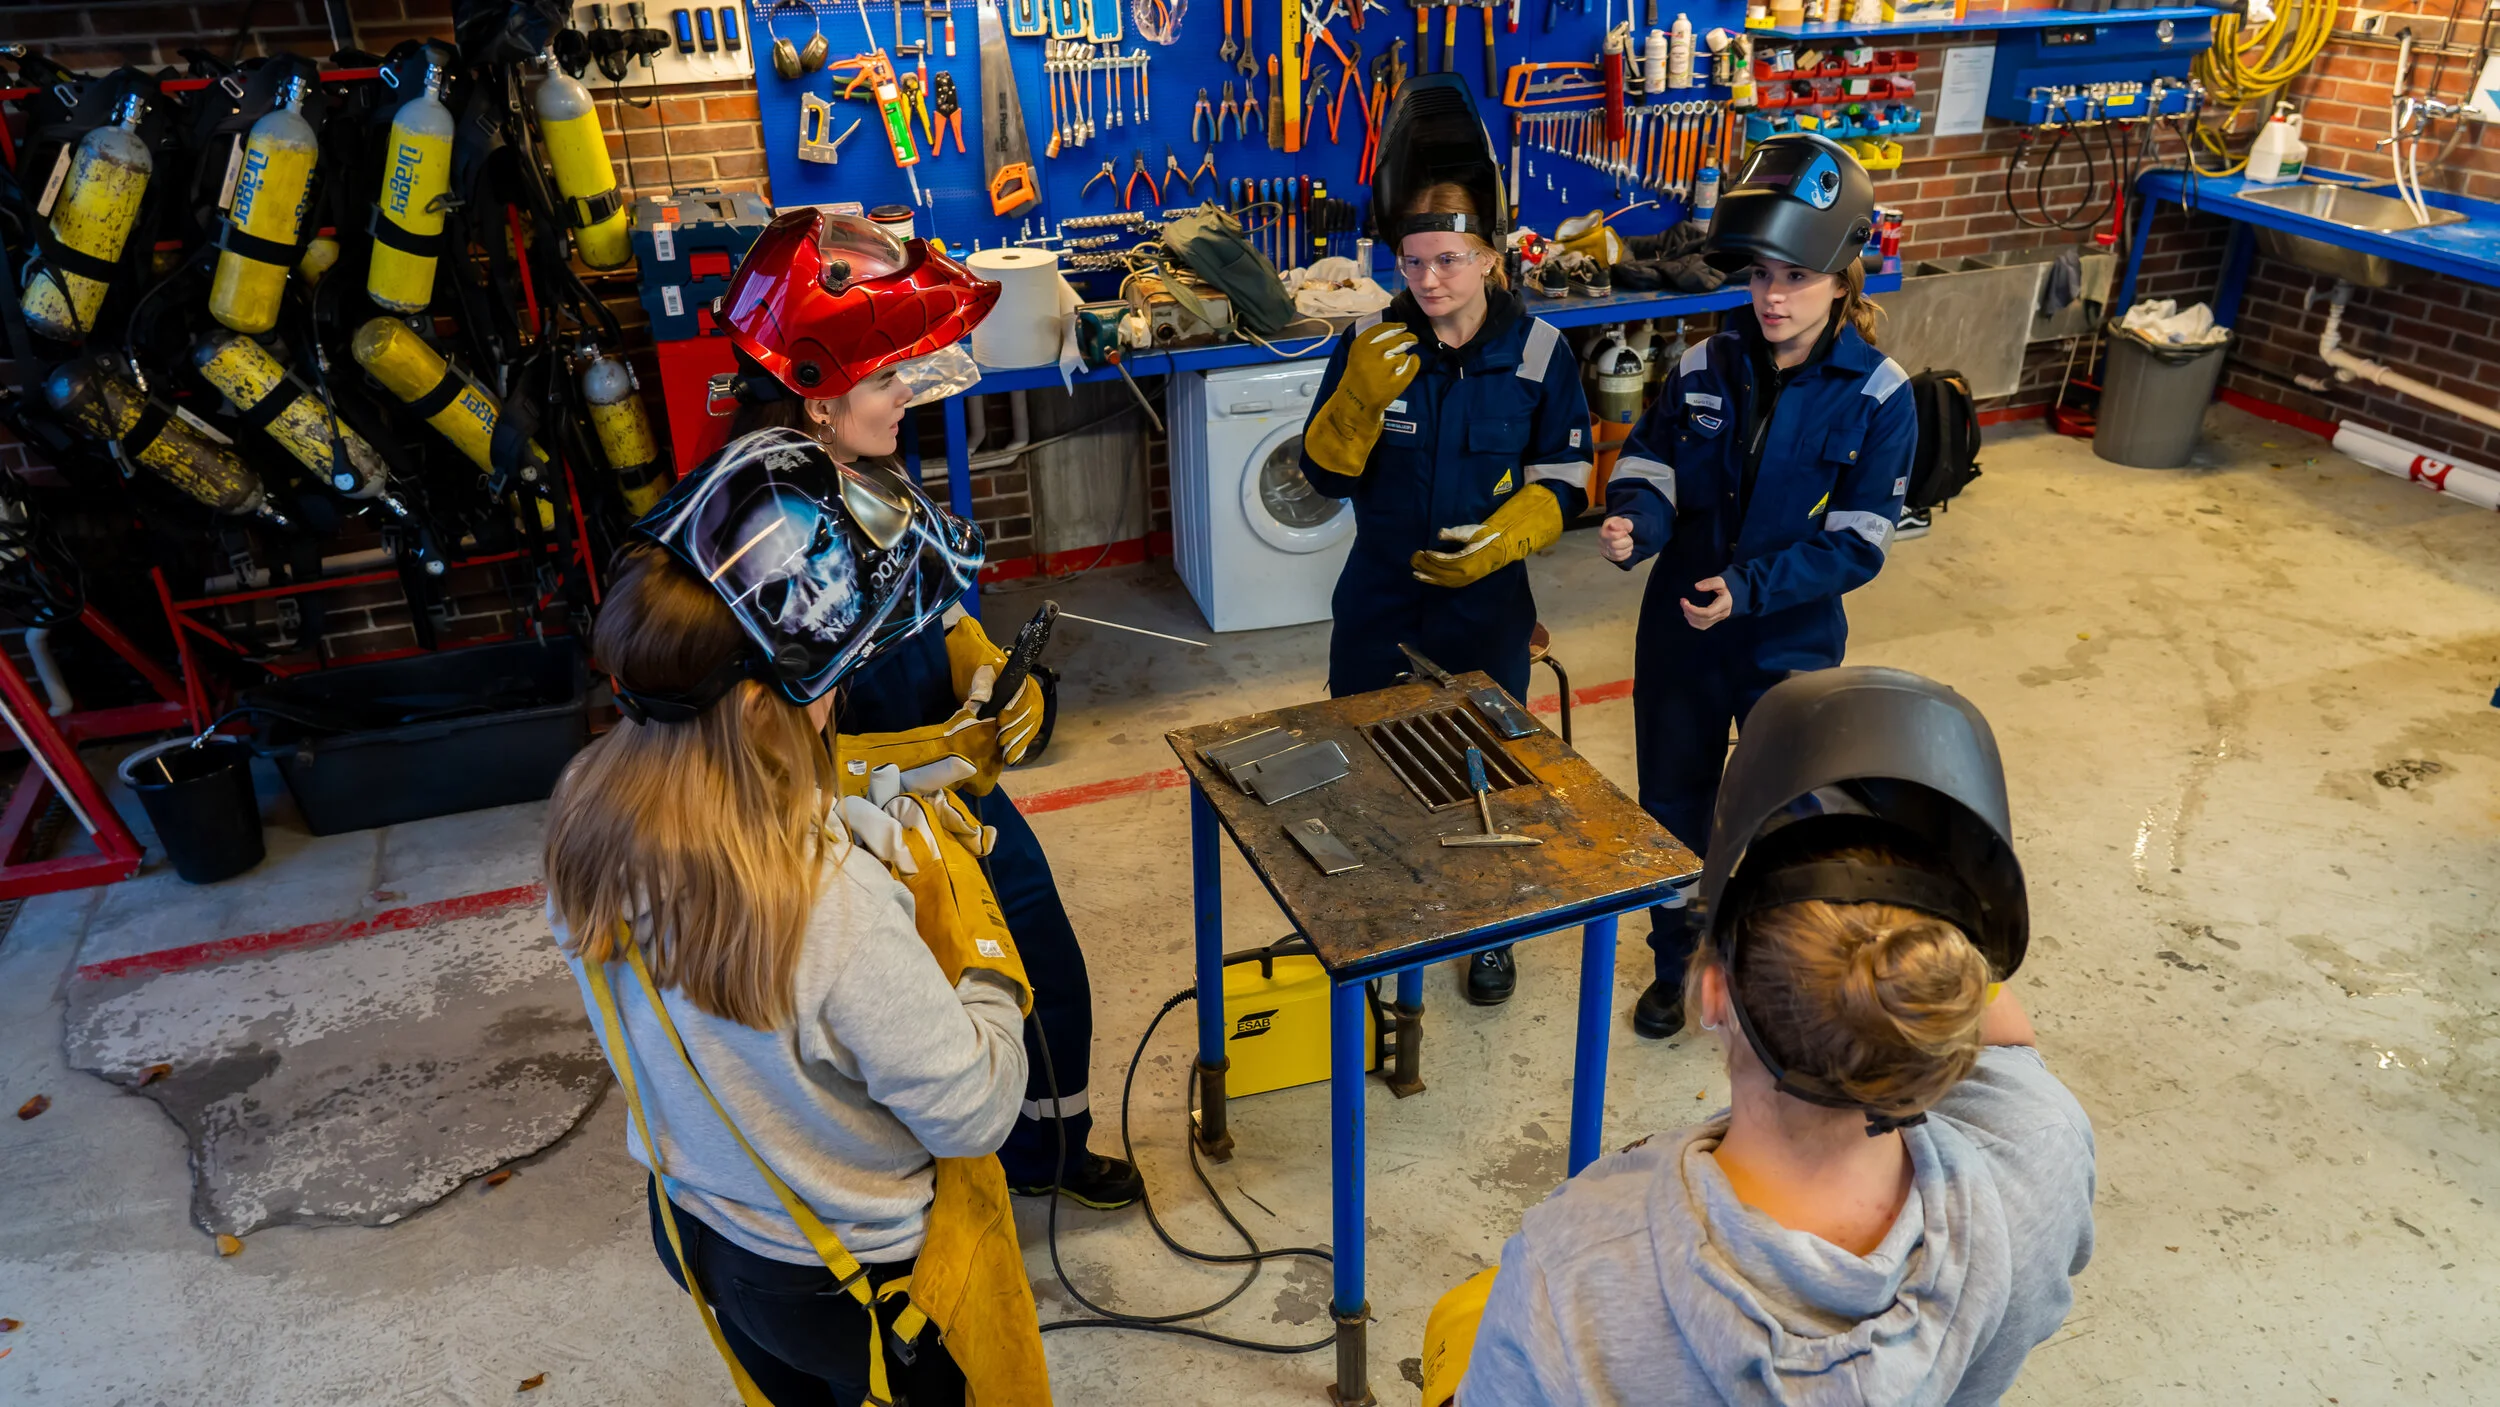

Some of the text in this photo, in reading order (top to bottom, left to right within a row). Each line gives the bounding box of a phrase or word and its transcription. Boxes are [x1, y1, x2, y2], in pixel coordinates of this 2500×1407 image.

[234, 148, 269, 225] Dräger
[389, 143, 423, 217] Dräger
[860, 641, 876, 658] 3M
[1237, 1018, 1270, 1032] ESAB
